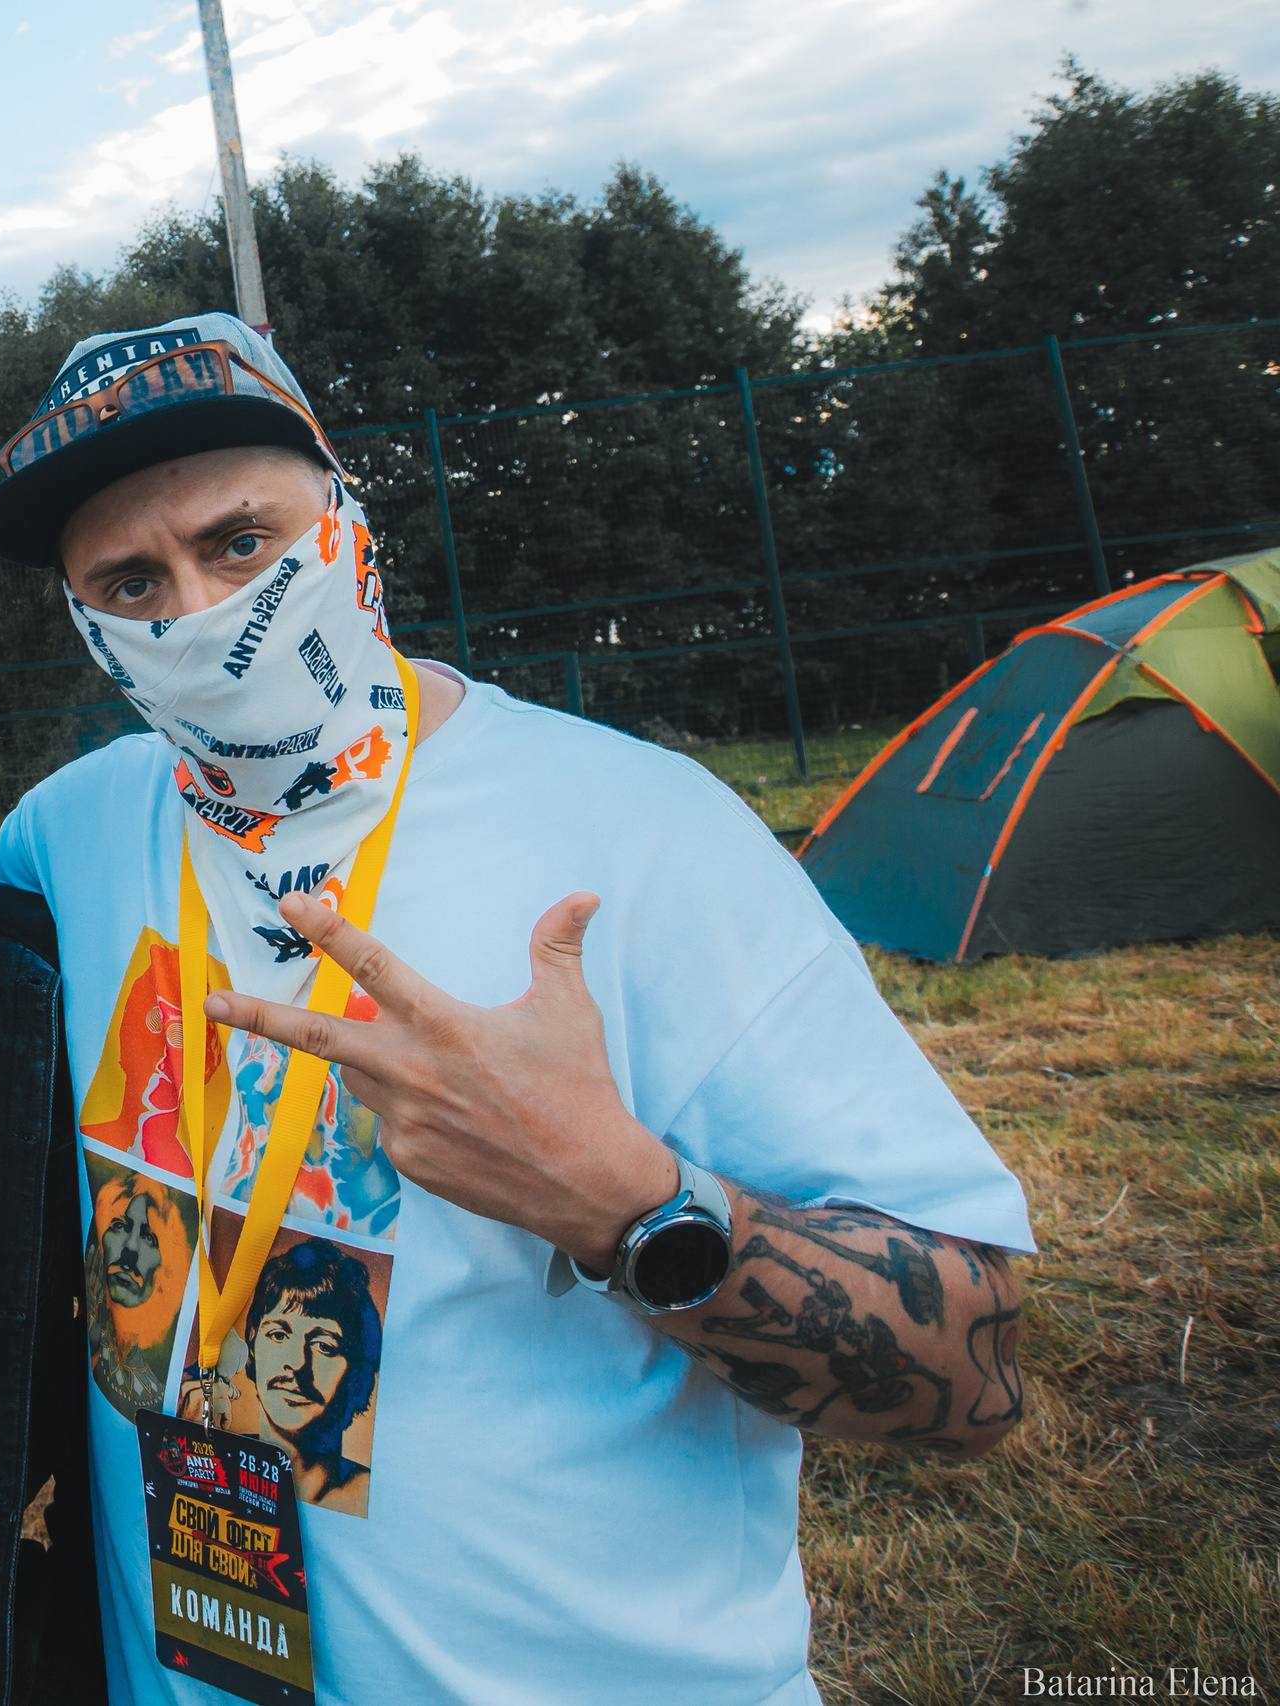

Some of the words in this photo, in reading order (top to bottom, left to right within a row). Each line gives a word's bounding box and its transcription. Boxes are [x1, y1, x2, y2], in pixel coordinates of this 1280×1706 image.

[188, 1467, 216, 1481] PARTY
[239, 1469, 278, 1502] ИЮНЯ
[176, 1498, 220, 1541] СВОЙ
[226, 1519, 272, 1552] ФЕСТ
[171, 1529, 204, 1566] ДЛЯ
[170, 1583, 289, 1659] КОМАНДА
